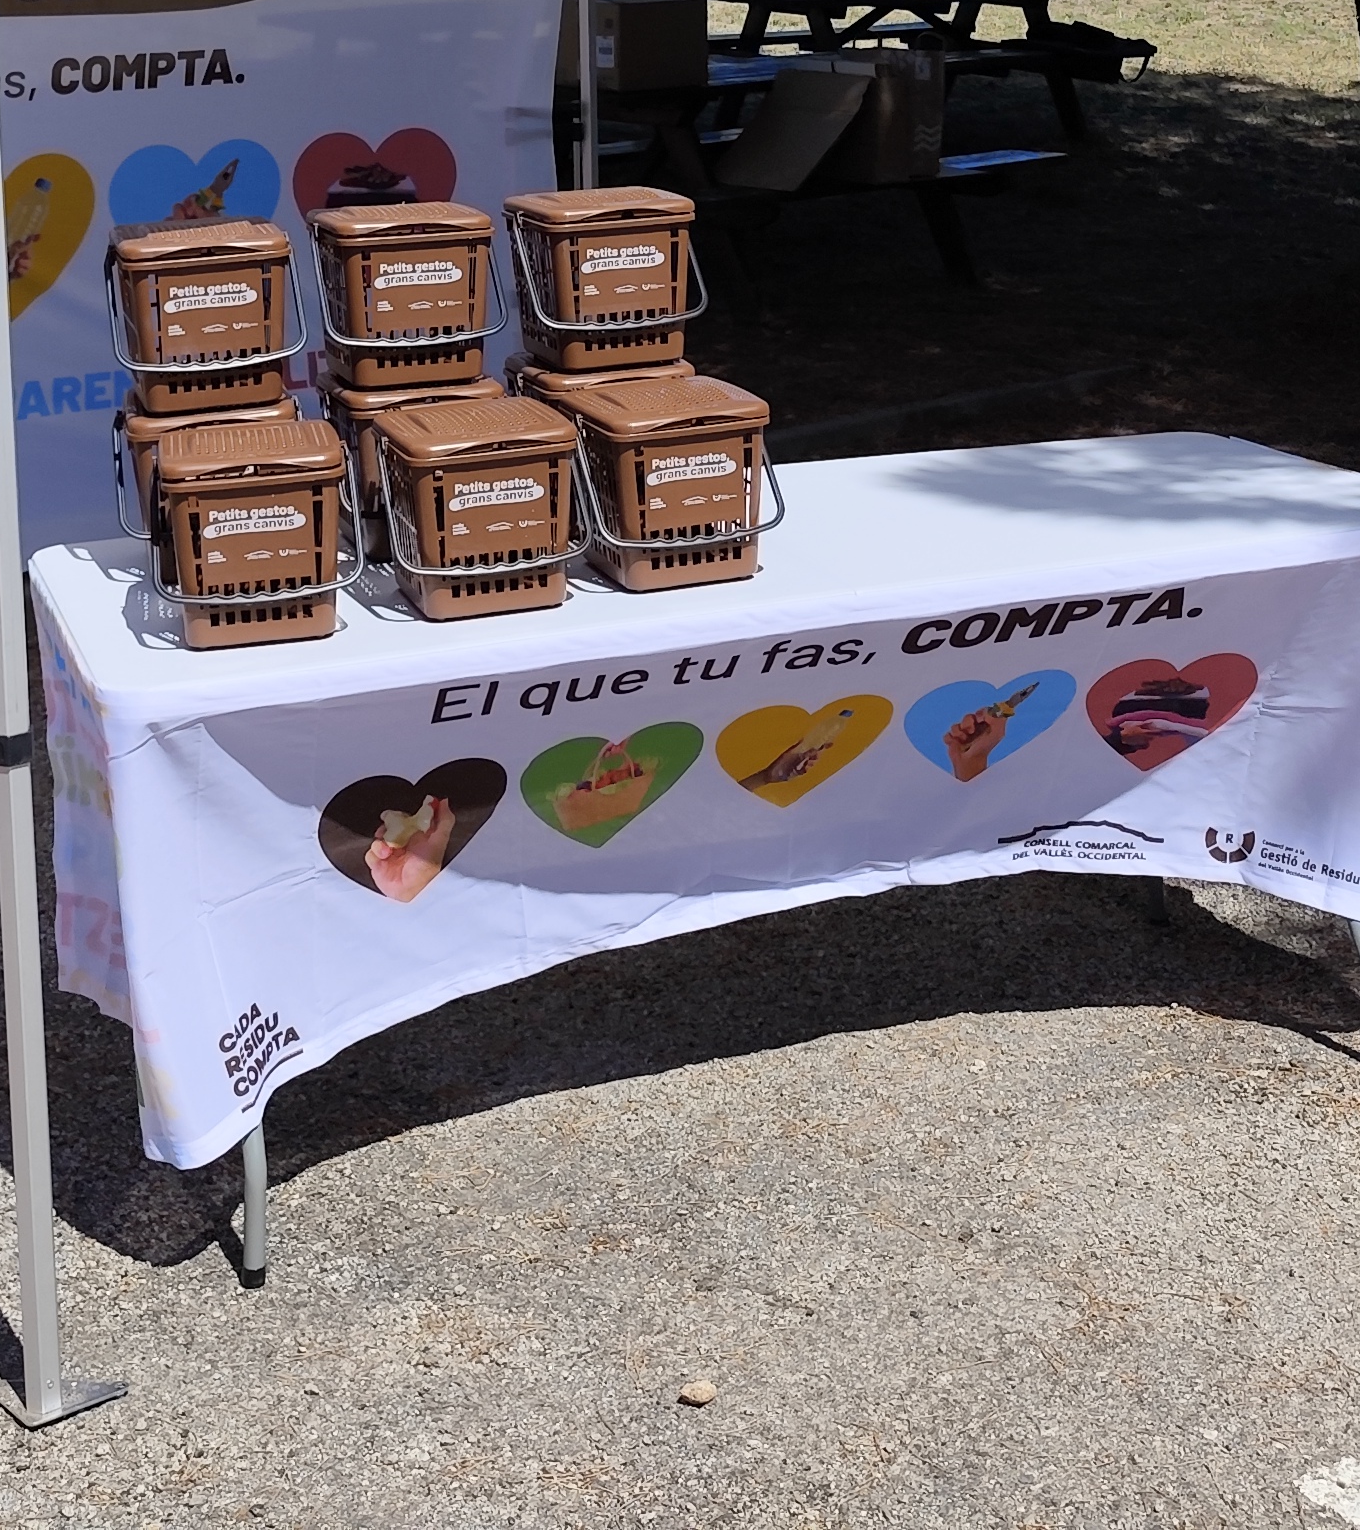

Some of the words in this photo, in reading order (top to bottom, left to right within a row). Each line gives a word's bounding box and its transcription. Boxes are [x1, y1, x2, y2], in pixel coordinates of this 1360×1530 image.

[51, 49, 245, 95] COMPTA.
[586, 247, 618, 260] Petits
[619, 244, 659, 258] gestos,
[380, 261, 413, 274] Petits
[415, 260, 456, 273] gestos,
[590, 257, 620, 271] grans
[622, 253, 656, 266] canvis
[383, 274, 415, 286] grans
[417, 272, 453, 282] canvis
[169, 284, 205, 298] Petits
[206, 280, 251, 296] gestos,
[173, 296, 208, 310] grans
[210, 291, 248, 305] canvis
[651, 454, 686, 470] Petits
[687, 452, 730, 468] gestos,
[656, 469, 689, 482] grans
[690, 463, 727, 476] canvis
[454, 480, 491, 495] Petits
[492, 477, 537, 492] gestos,
[459, 493, 493, 507] grans
[495, 489, 534, 501] canvis
[208, 507, 248, 522] Petits
[249, 504, 299, 519] gestos,
[214, 521, 250, 535] grans
[253, 516, 295, 529] canvis
[431, 680, 500, 725] El
[519, 669, 649, 717] que
[672, 654, 741, 685] tu
[760, 639, 877, 674] fas,
[901, 586, 1204, 655] COMPTA.
[1023, 838, 1072, 848] CONSELL
[1075, 841, 1136, 850] COMARCAL
[1012, 850, 1030, 861] DEL
[1077, 851, 1147, 861] OCCIDENTAL
[1260, 847, 1298, 867] Gestió
[1302, 859, 1317, 873] de
[218, 1002, 262, 1053] CADA
[224, 1011, 279, 1078] RESIDU
[233, 1026, 301, 1097] COMPTA
